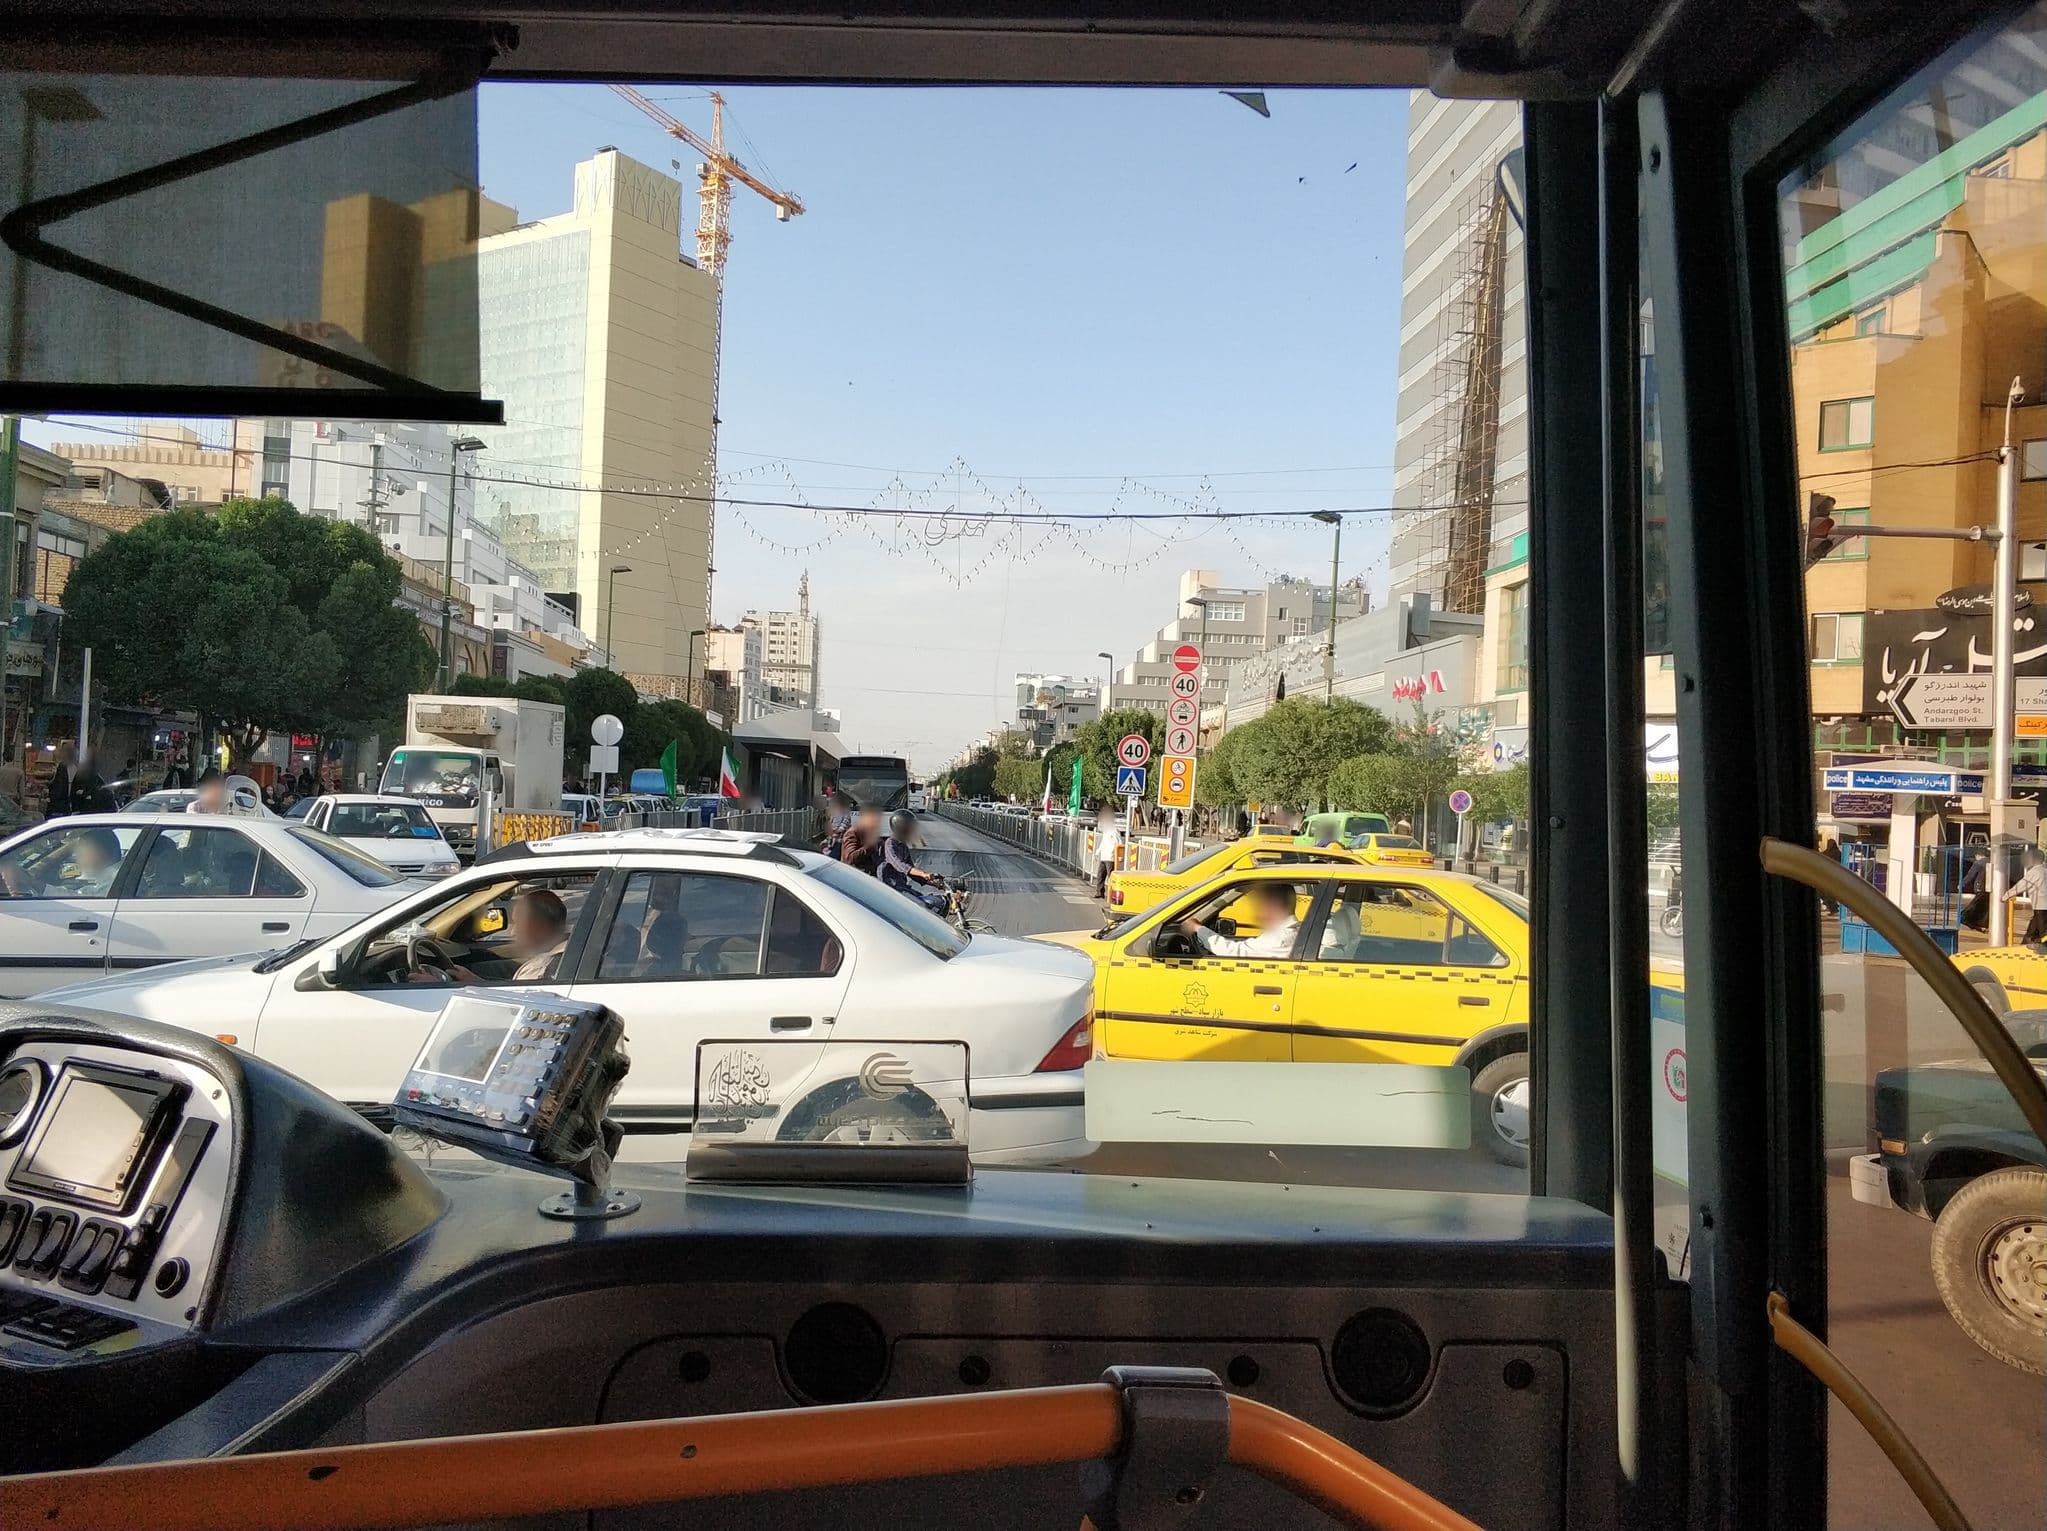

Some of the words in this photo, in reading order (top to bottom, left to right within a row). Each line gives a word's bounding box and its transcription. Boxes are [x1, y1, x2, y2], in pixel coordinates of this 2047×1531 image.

[1176, 679, 1195, 692] 40
[1924, 682, 1960, 692] اندرزگو
[1963, 681, 1987, 689] شهید
[1924, 695, 1958, 704] طبرسی
[1124, 744, 1144, 758] 40
[1827, 774, 1848, 785] police
[1855, 775, 1875, 785] مشهد
[1874, 776, 1898, 786] رانندگی
[1902, 776, 1931, 787] راهنمایی
[1930, 778, 1948, 788] پلیس
[1957, 779, 1983, 790] police
